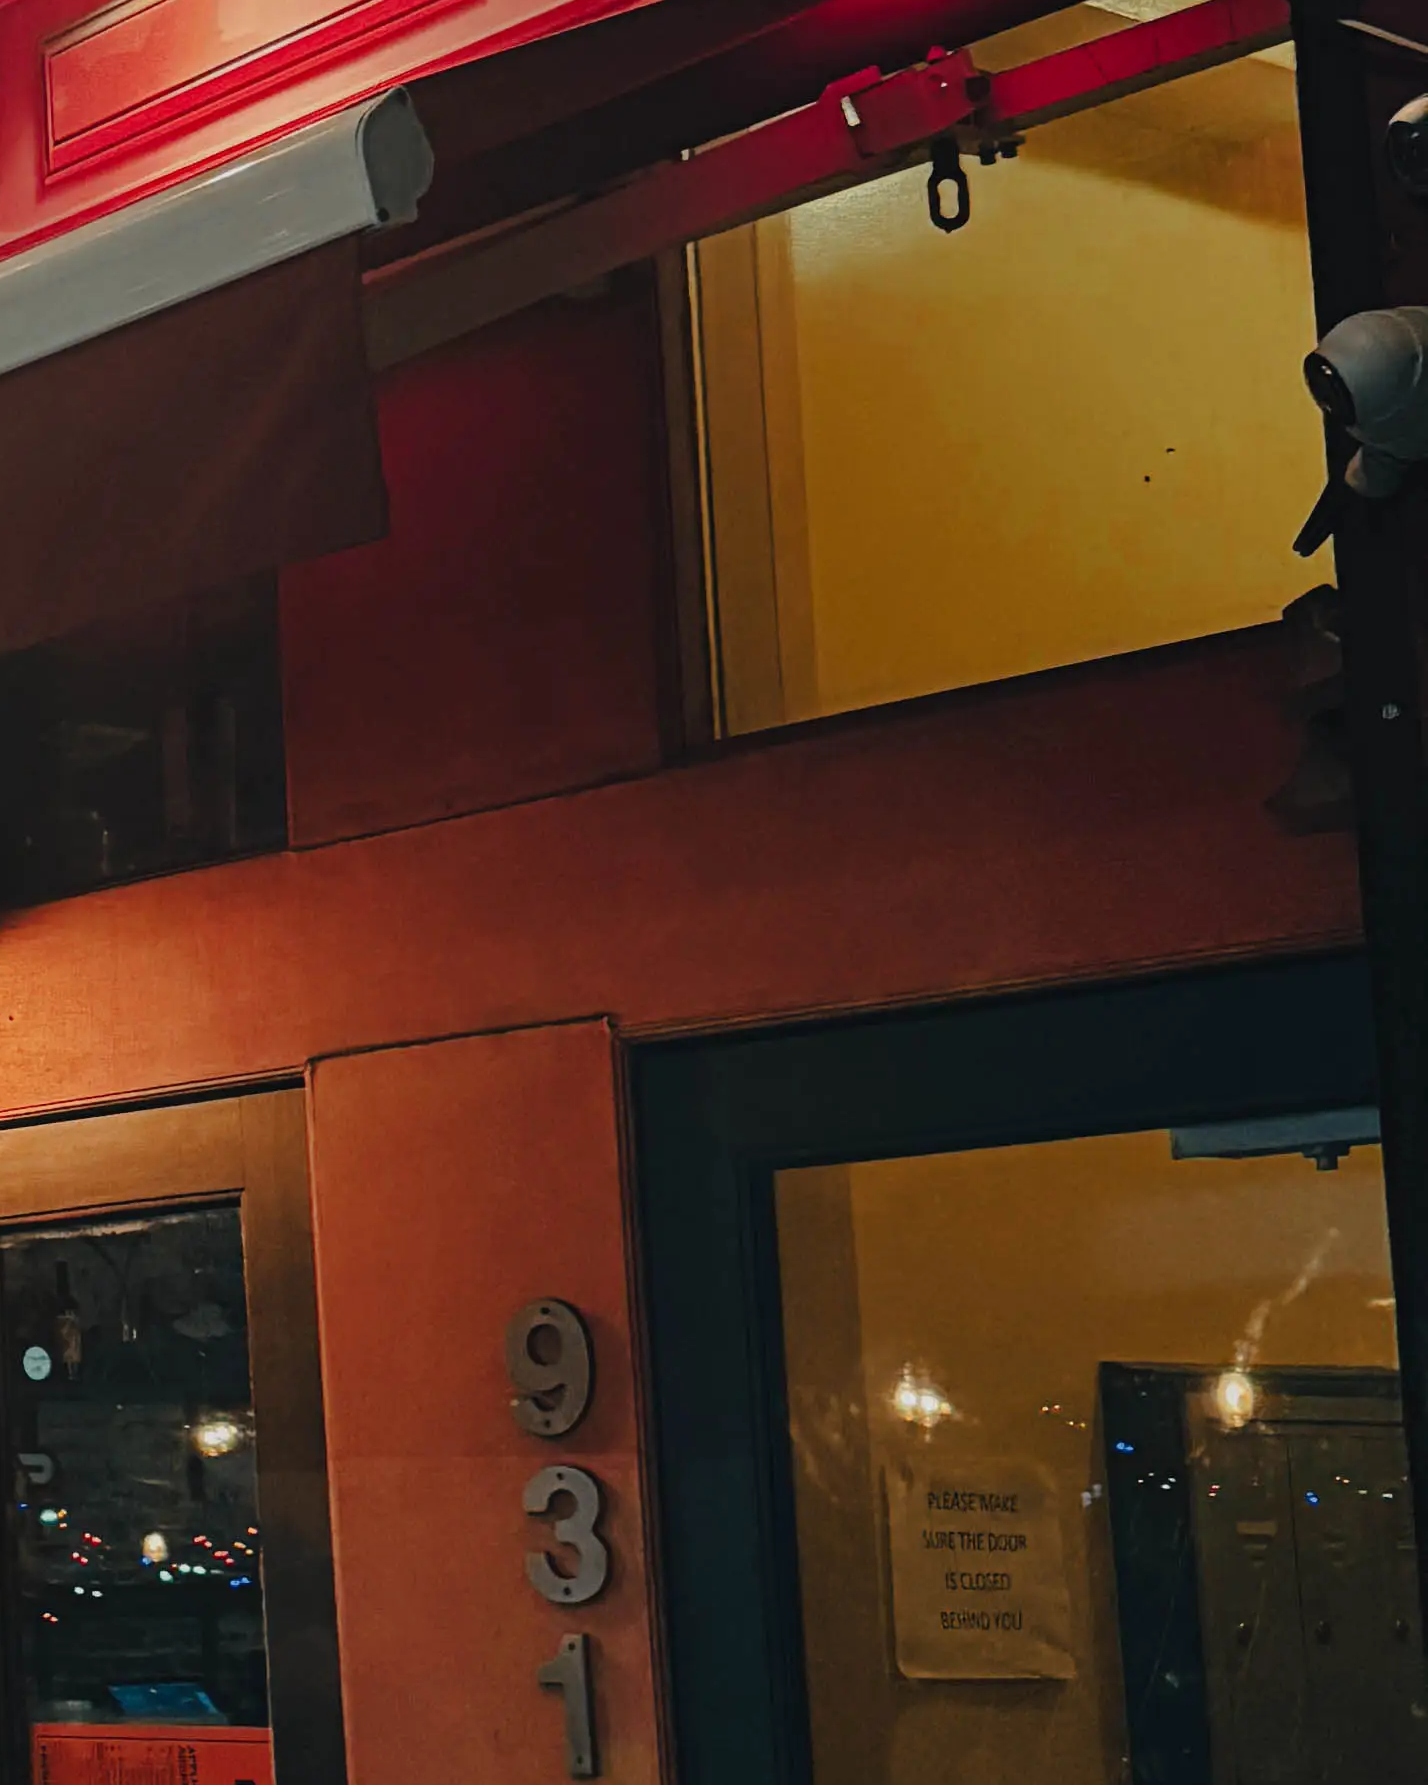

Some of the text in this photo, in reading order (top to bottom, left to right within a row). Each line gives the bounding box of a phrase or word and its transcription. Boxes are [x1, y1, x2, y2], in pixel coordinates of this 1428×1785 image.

[927, 1492, 1019, 1513] PLEASE MAKE
[958, 1531, 985, 1551] THE
[988, 1532, 1028, 1552] DOOR
[945, 1572, 1012, 1591] IS CLOSED
[940, 1610, 1023, 1631] BEHIND YOU
